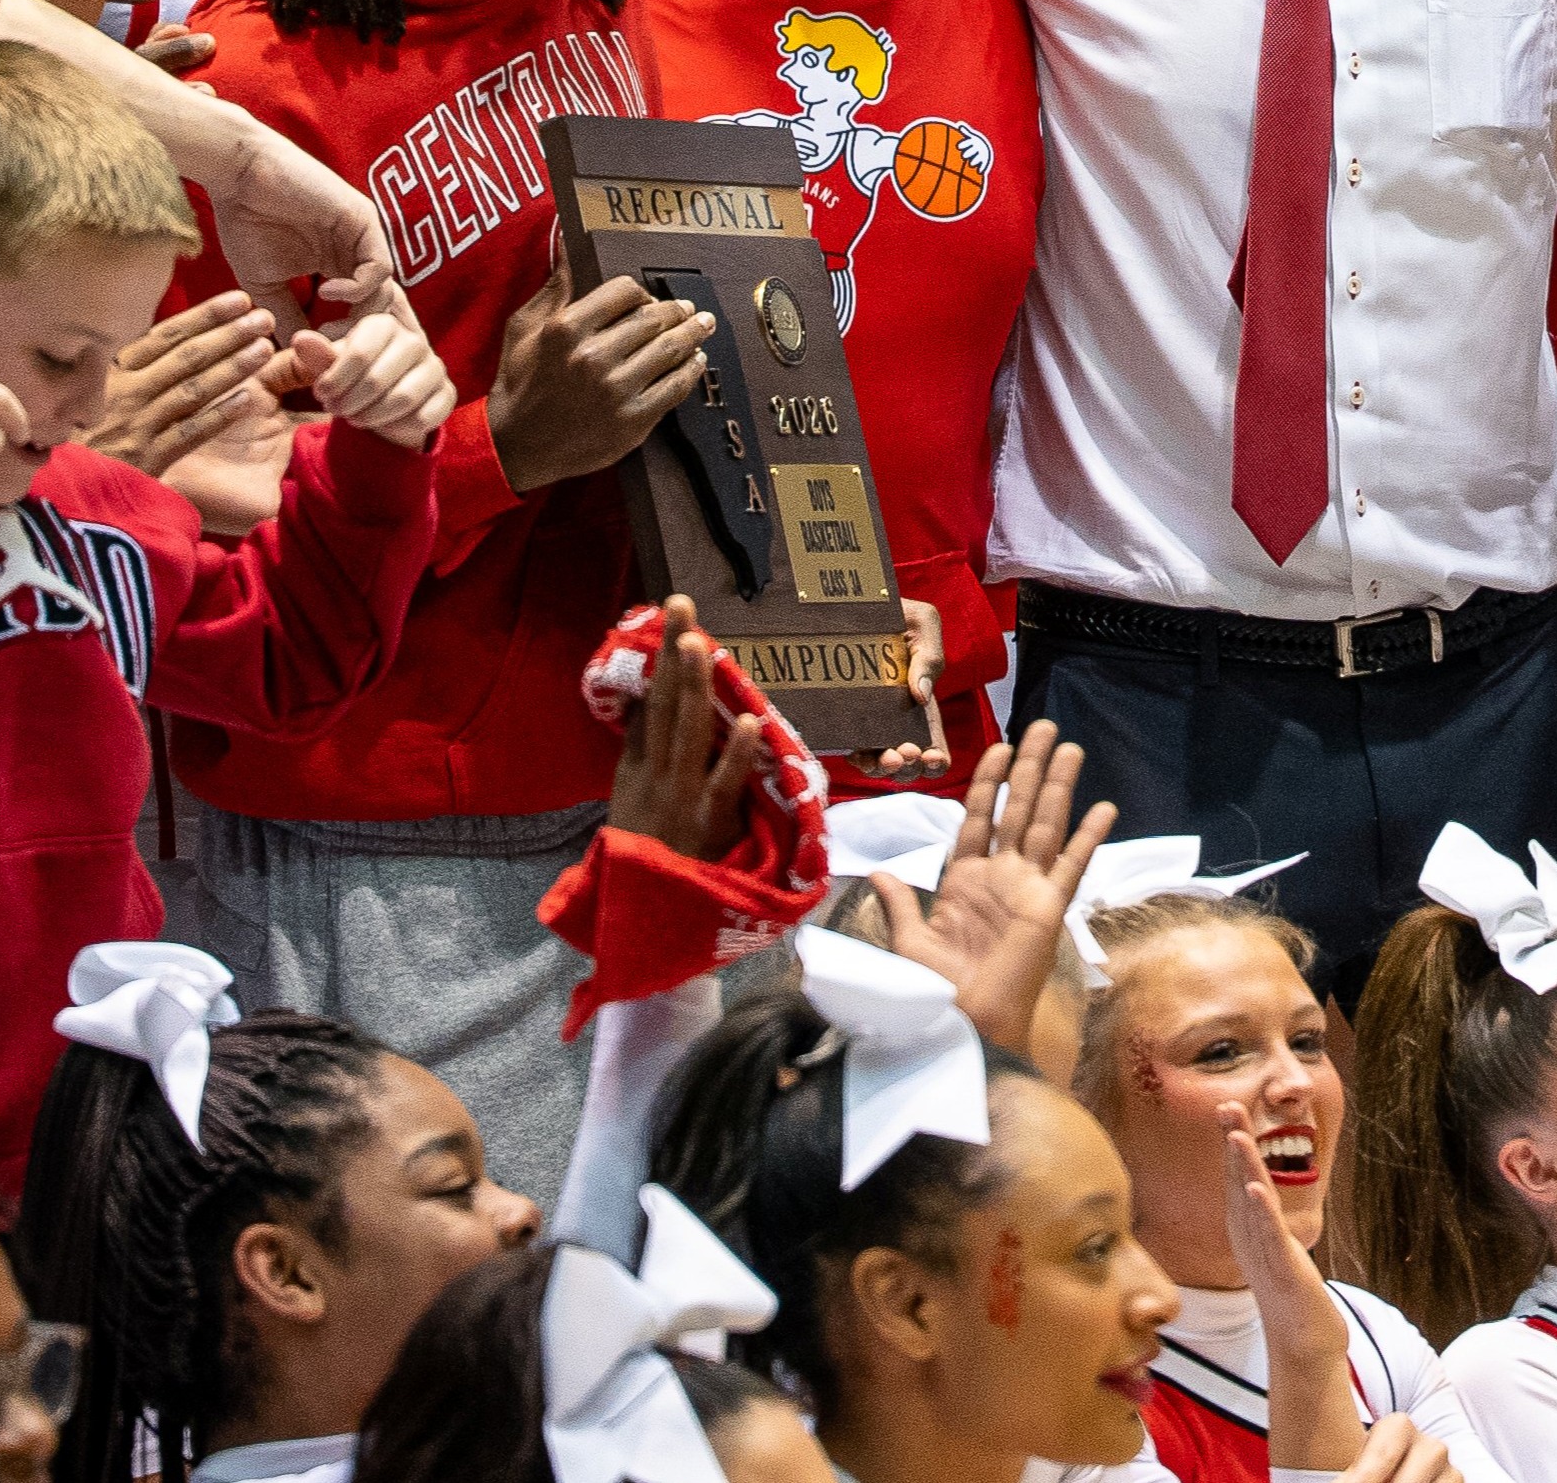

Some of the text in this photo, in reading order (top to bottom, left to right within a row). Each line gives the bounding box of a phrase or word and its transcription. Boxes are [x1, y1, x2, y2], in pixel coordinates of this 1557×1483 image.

[604, 185, 784, 231] REGIONAL
[771, 394, 839, 435] 2026
[807, 479, 836, 512] BOYS
[799, 520, 862, 554] BASKETBALL
[819, 569, 848, 597] CLASS
[725, 642, 900, 684] AMPIONS
